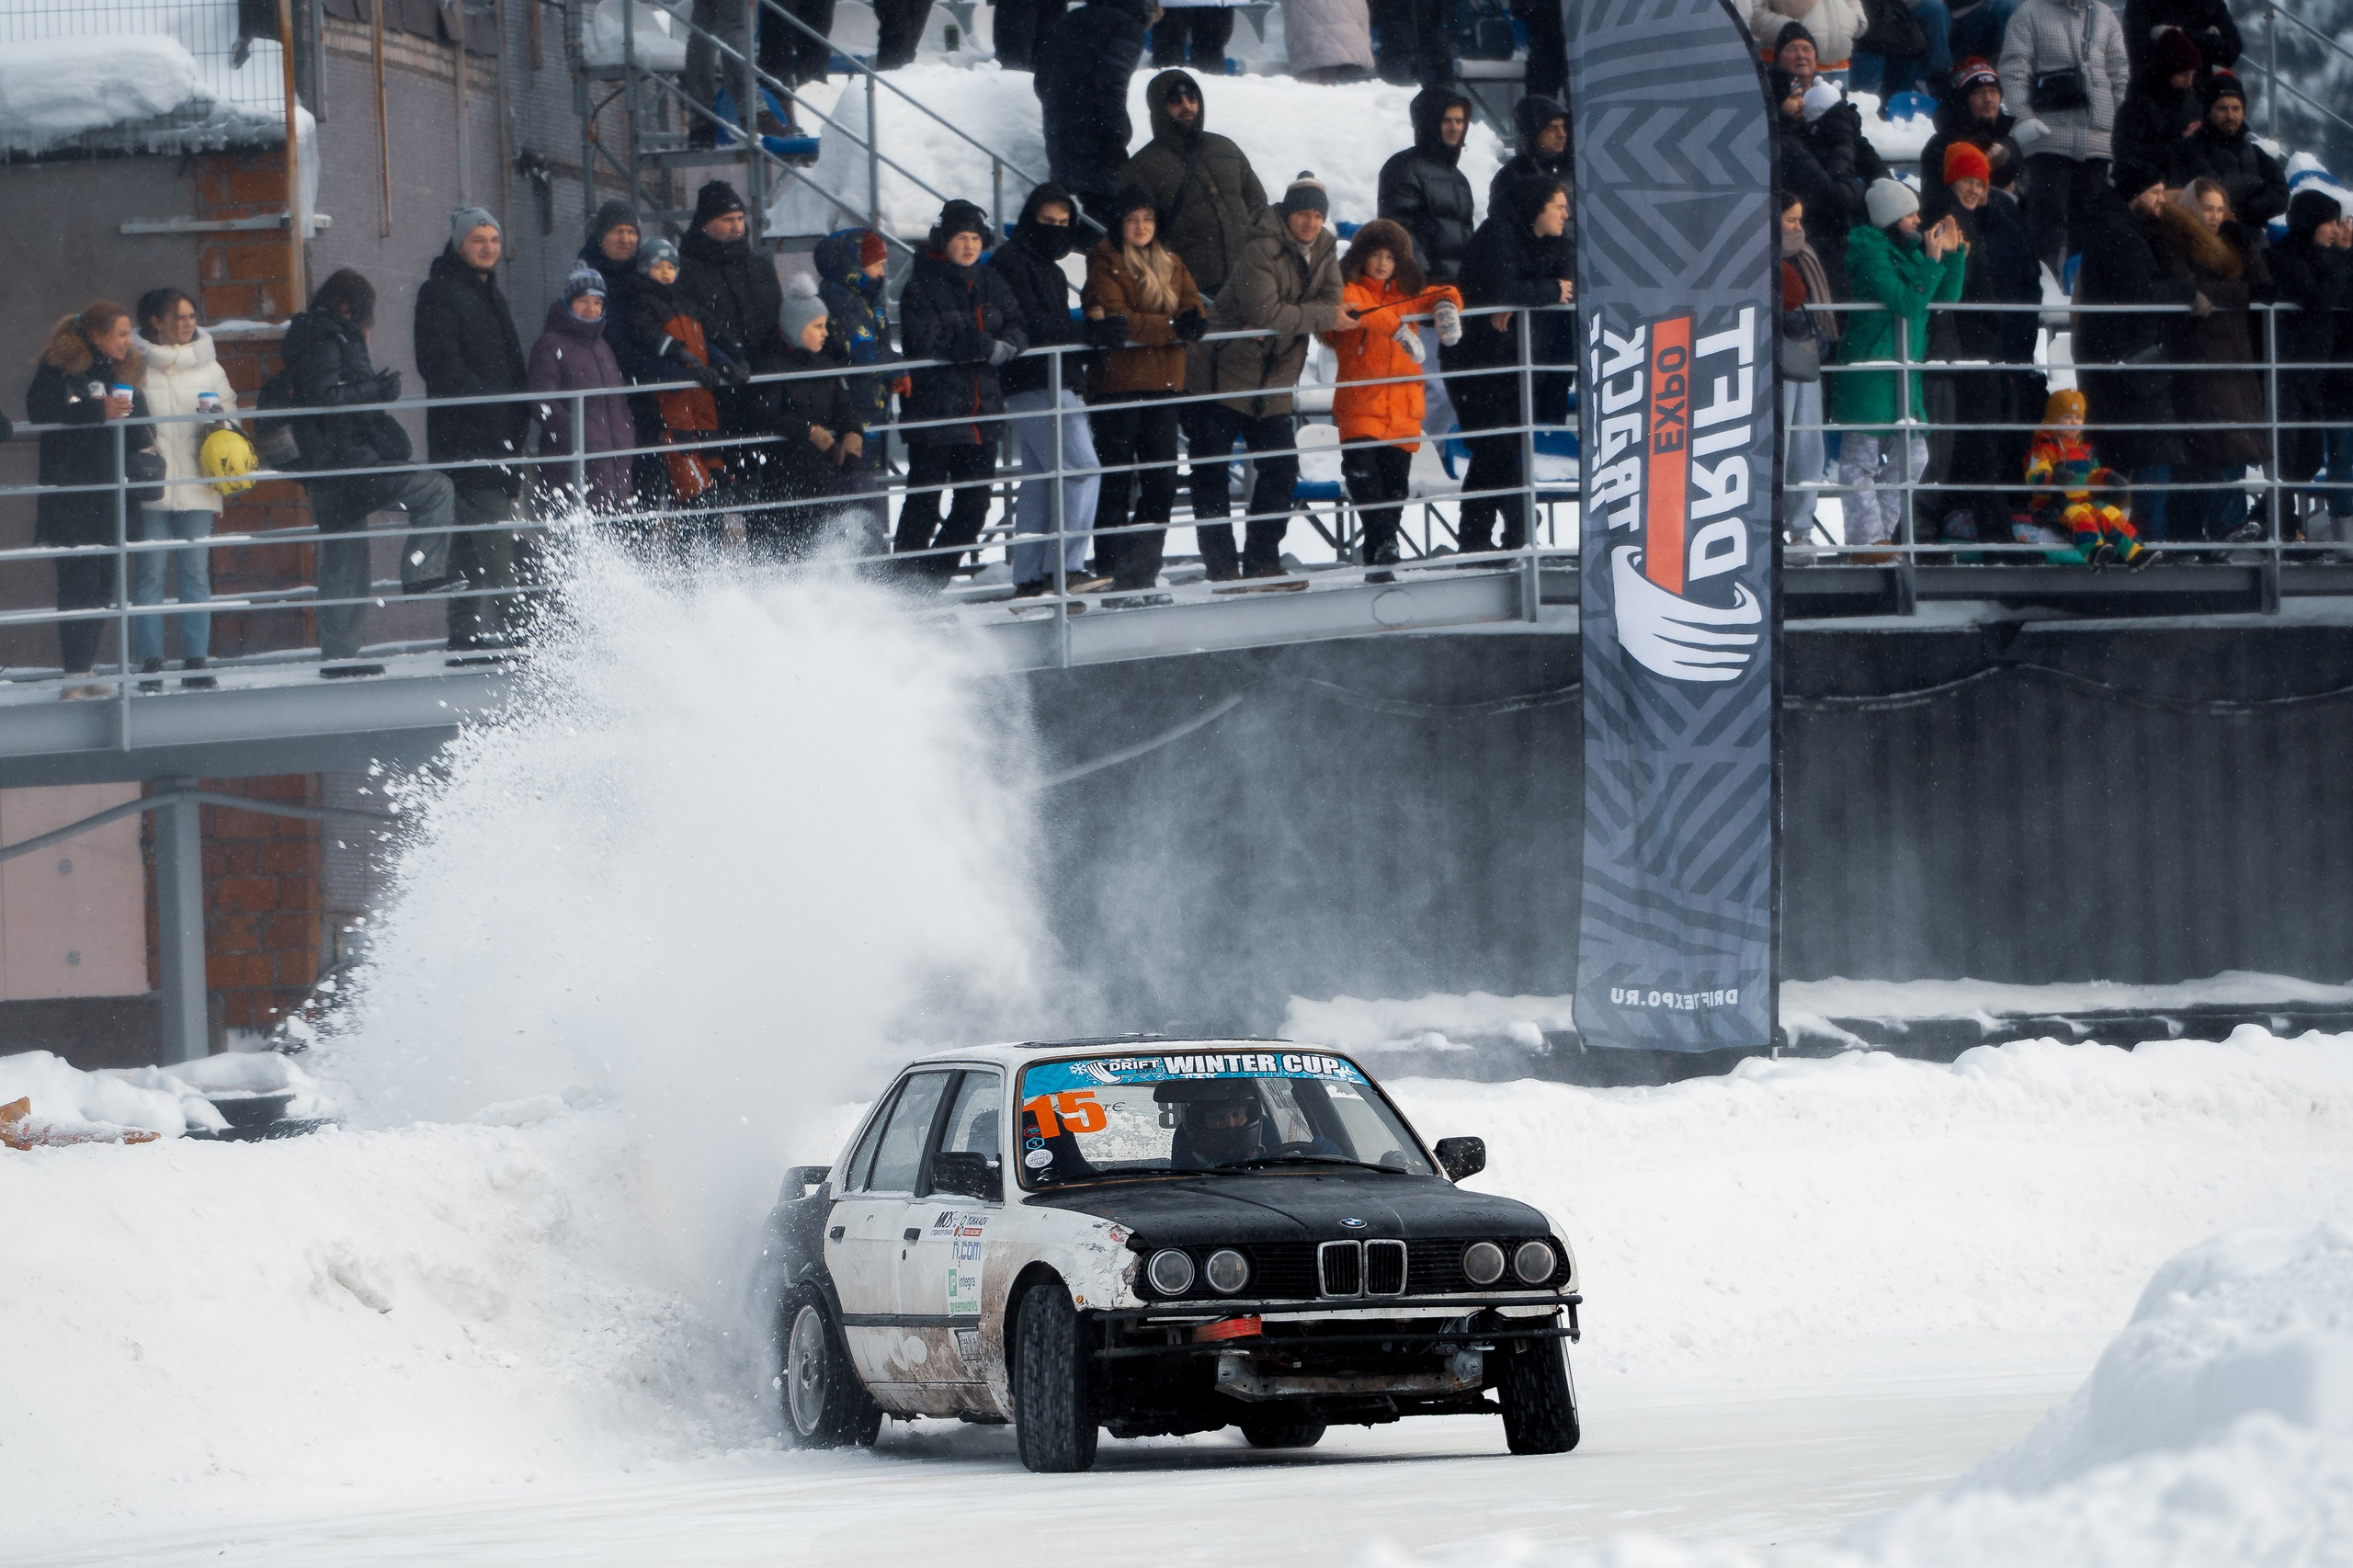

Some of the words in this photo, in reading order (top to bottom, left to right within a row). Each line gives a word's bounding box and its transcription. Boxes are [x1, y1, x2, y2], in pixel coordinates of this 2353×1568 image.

[1108, 1059, 1161, 1072] DRIFT
[1164, 1055, 1278, 1074] WINTER
[1282, 1054, 1341, 1074] CUP
[1022, 1091, 1108, 1139] 15
